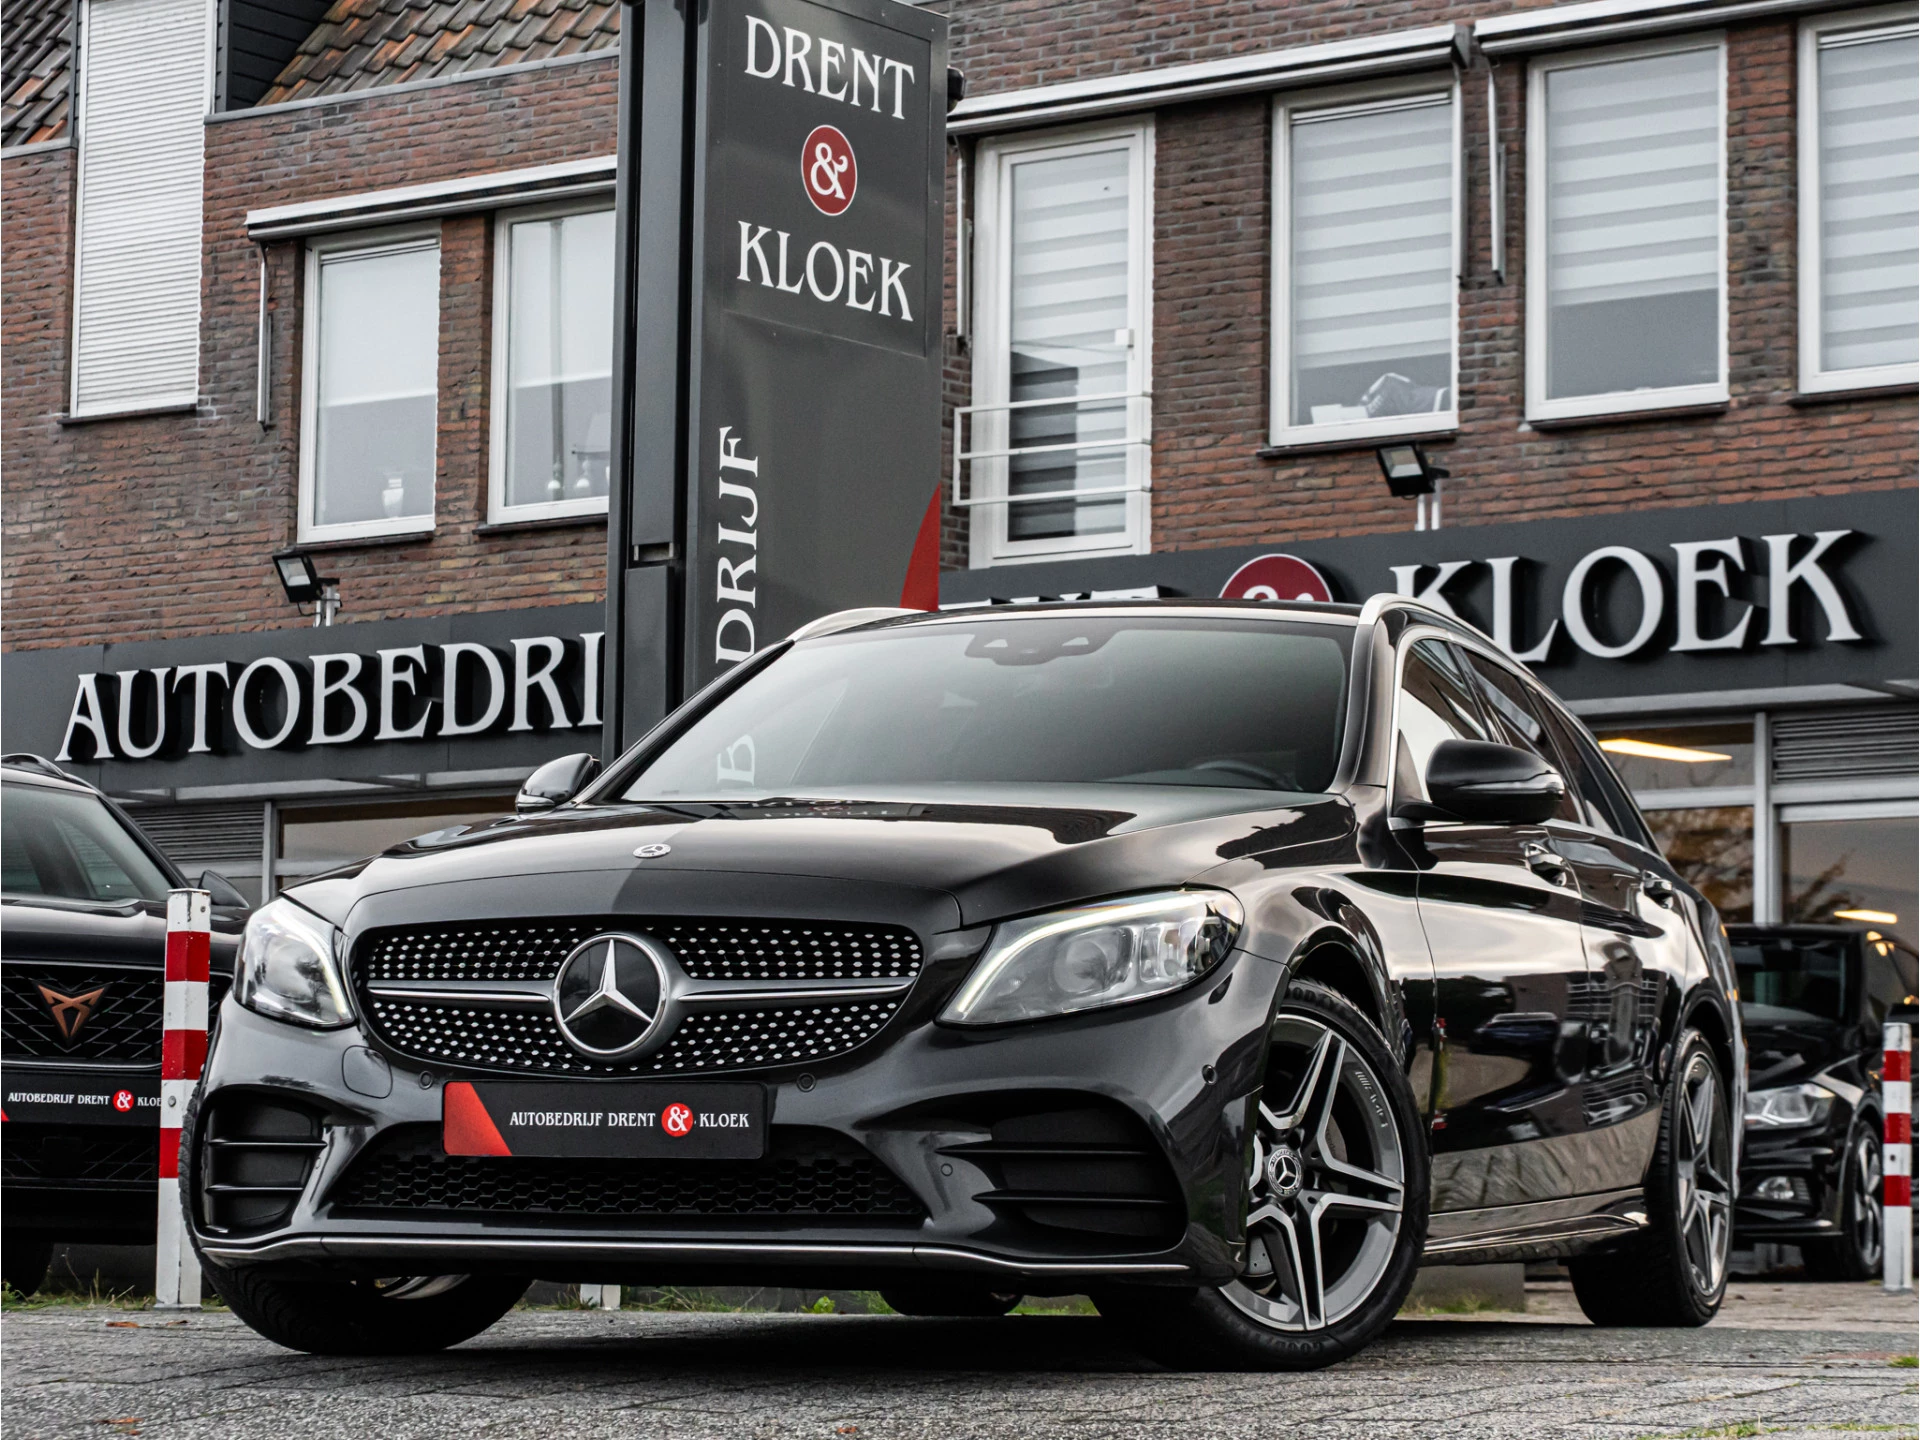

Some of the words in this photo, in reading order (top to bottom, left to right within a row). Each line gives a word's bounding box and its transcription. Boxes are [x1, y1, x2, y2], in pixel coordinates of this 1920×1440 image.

[744, 14, 915, 120] DRENT
[810, 142, 849, 200] &
[736, 220, 914, 322] KLOEK
[7, 1092, 75, 1104] AUTOBEDRIJF
[77, 1095, 110, 1105] DRENT
[116, 1091, 132, 1109] &
[508, 1111, 604, 1127] AUTOBEDRIJF
[607, 1112, 656, 1127] DRENT
[667, 1106, 690, 1132] &
[699, 1112, 750, 1128] KLOEK
